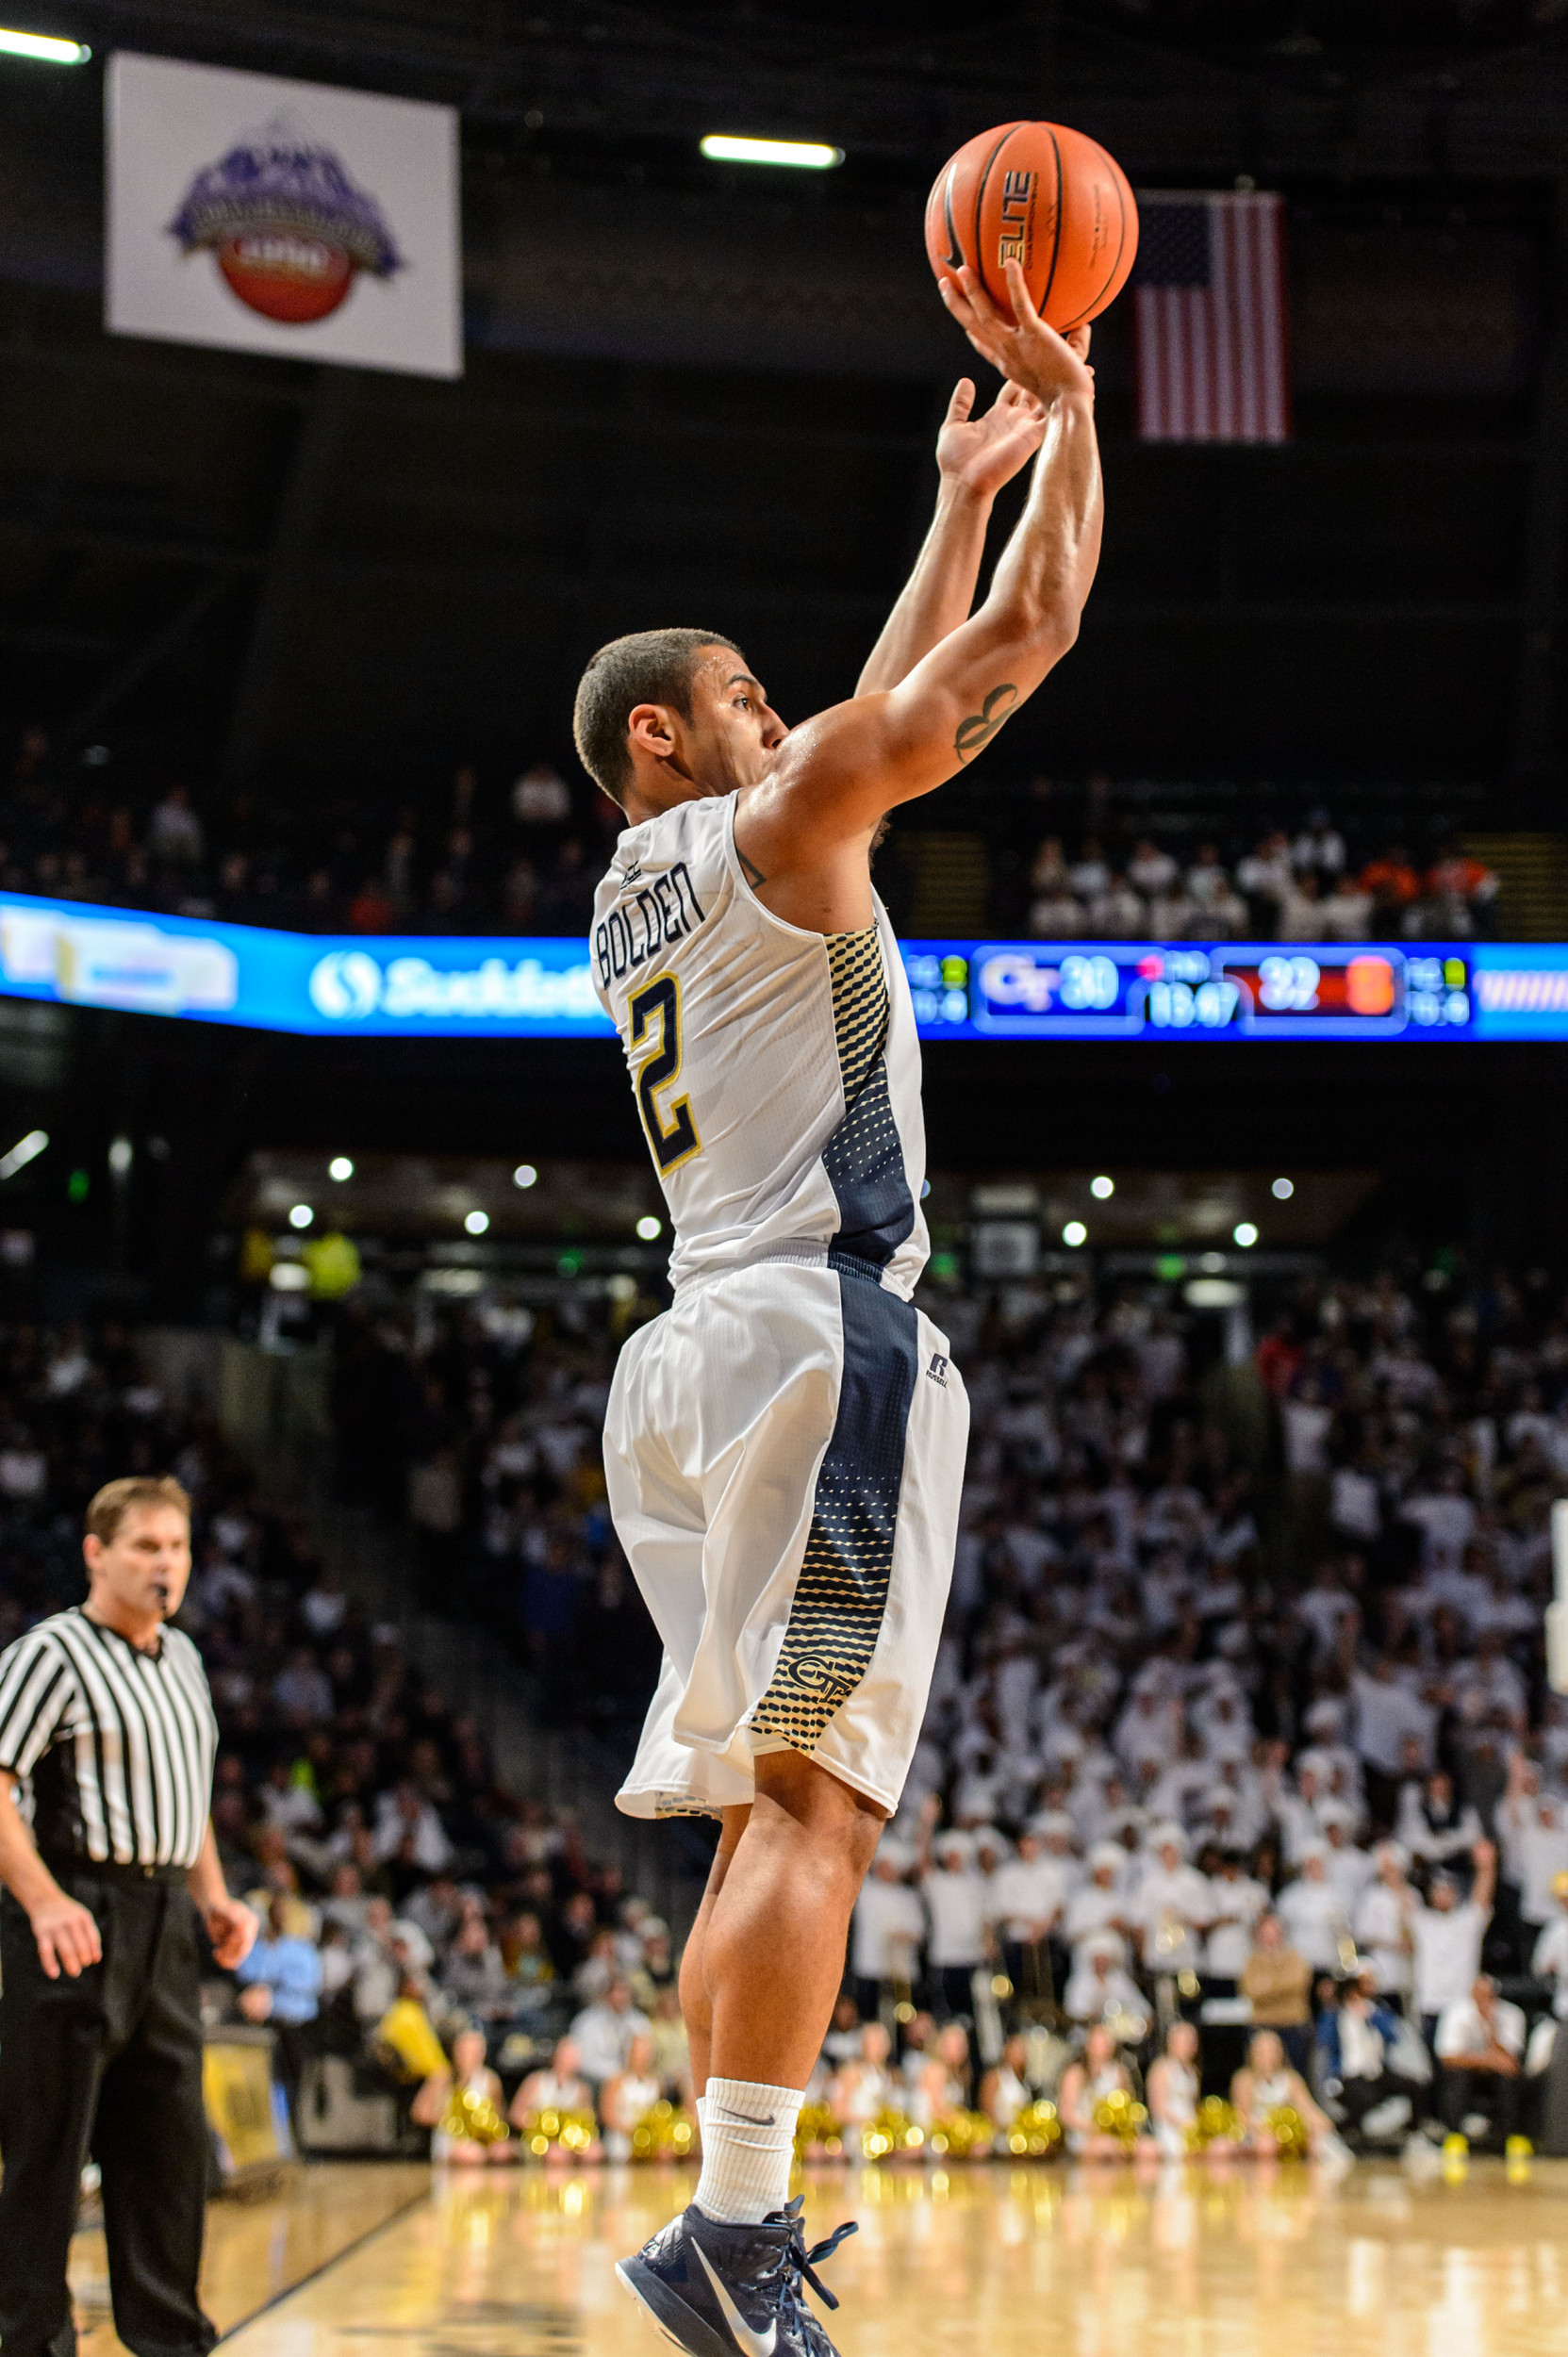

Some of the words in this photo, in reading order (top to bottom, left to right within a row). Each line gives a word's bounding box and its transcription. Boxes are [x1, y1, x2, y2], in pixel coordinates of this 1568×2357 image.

[998, 171, 1031, 269] ELITE
[597, 862, 705, 990] BOLDEN
[628, 969, 702, 1178] 2
[788, 1655, 852, 1704] GT
